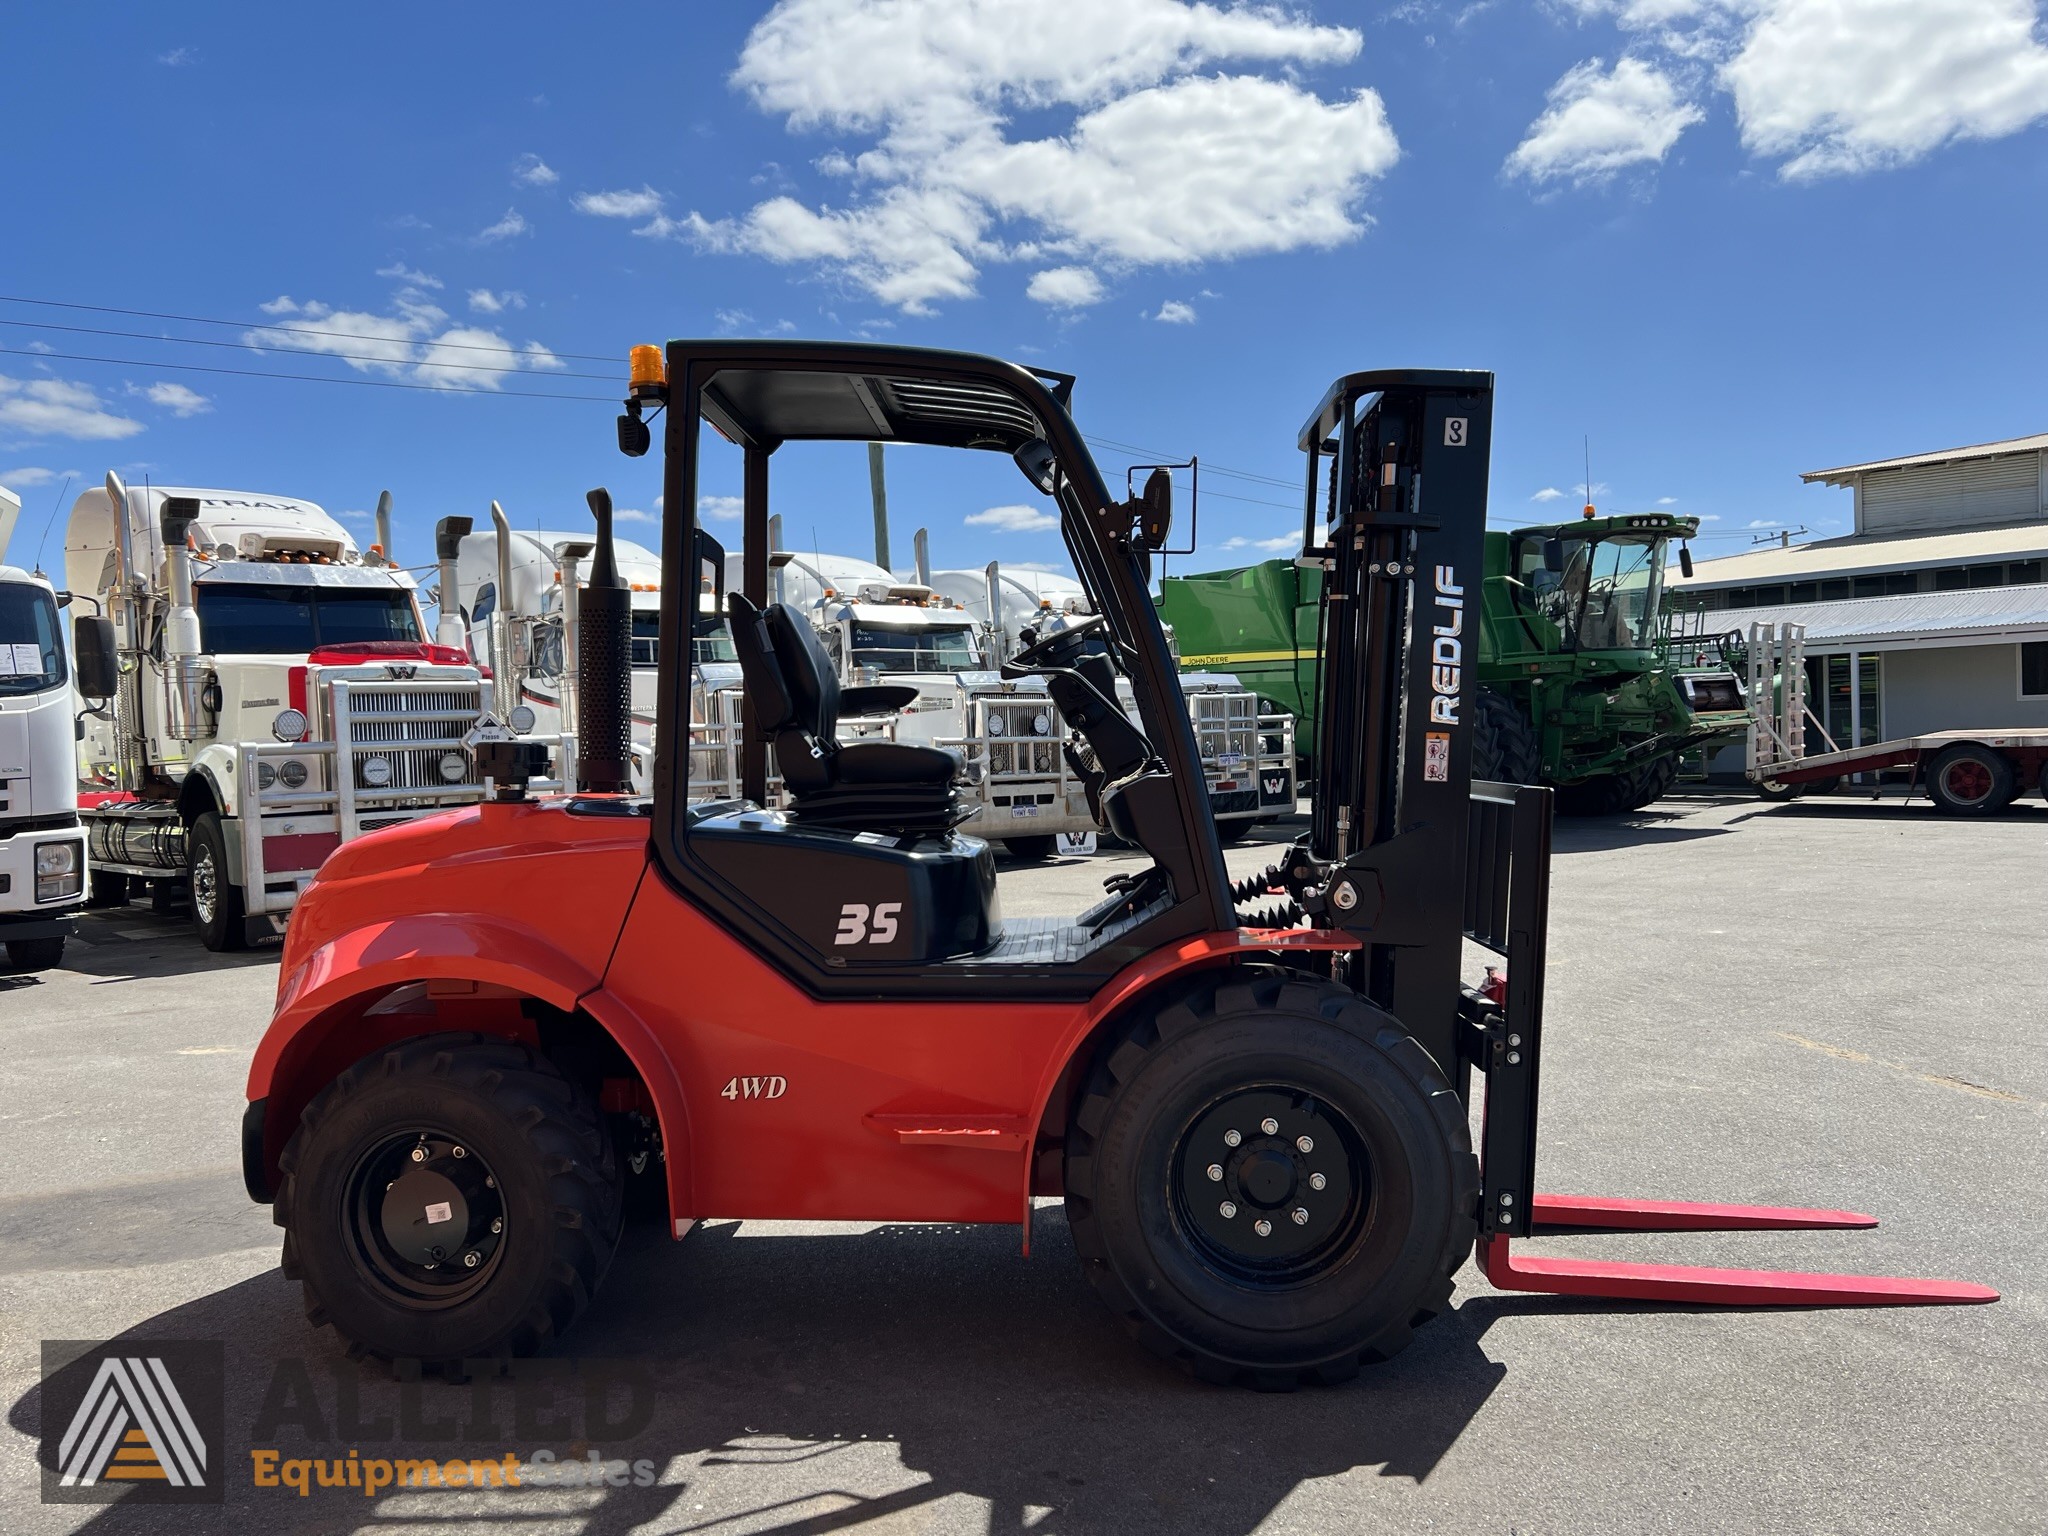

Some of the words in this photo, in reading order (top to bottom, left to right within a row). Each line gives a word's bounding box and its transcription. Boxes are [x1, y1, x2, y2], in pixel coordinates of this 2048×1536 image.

[200, 500, 305, 513] TRAX
[1430, 564, 1464, 725] REDLIF
[1188, 657, 1206, 665] JOHN
[1206, 656, 1229, 664] DEERE
[720, 1075, 788, 1101] 4WD
